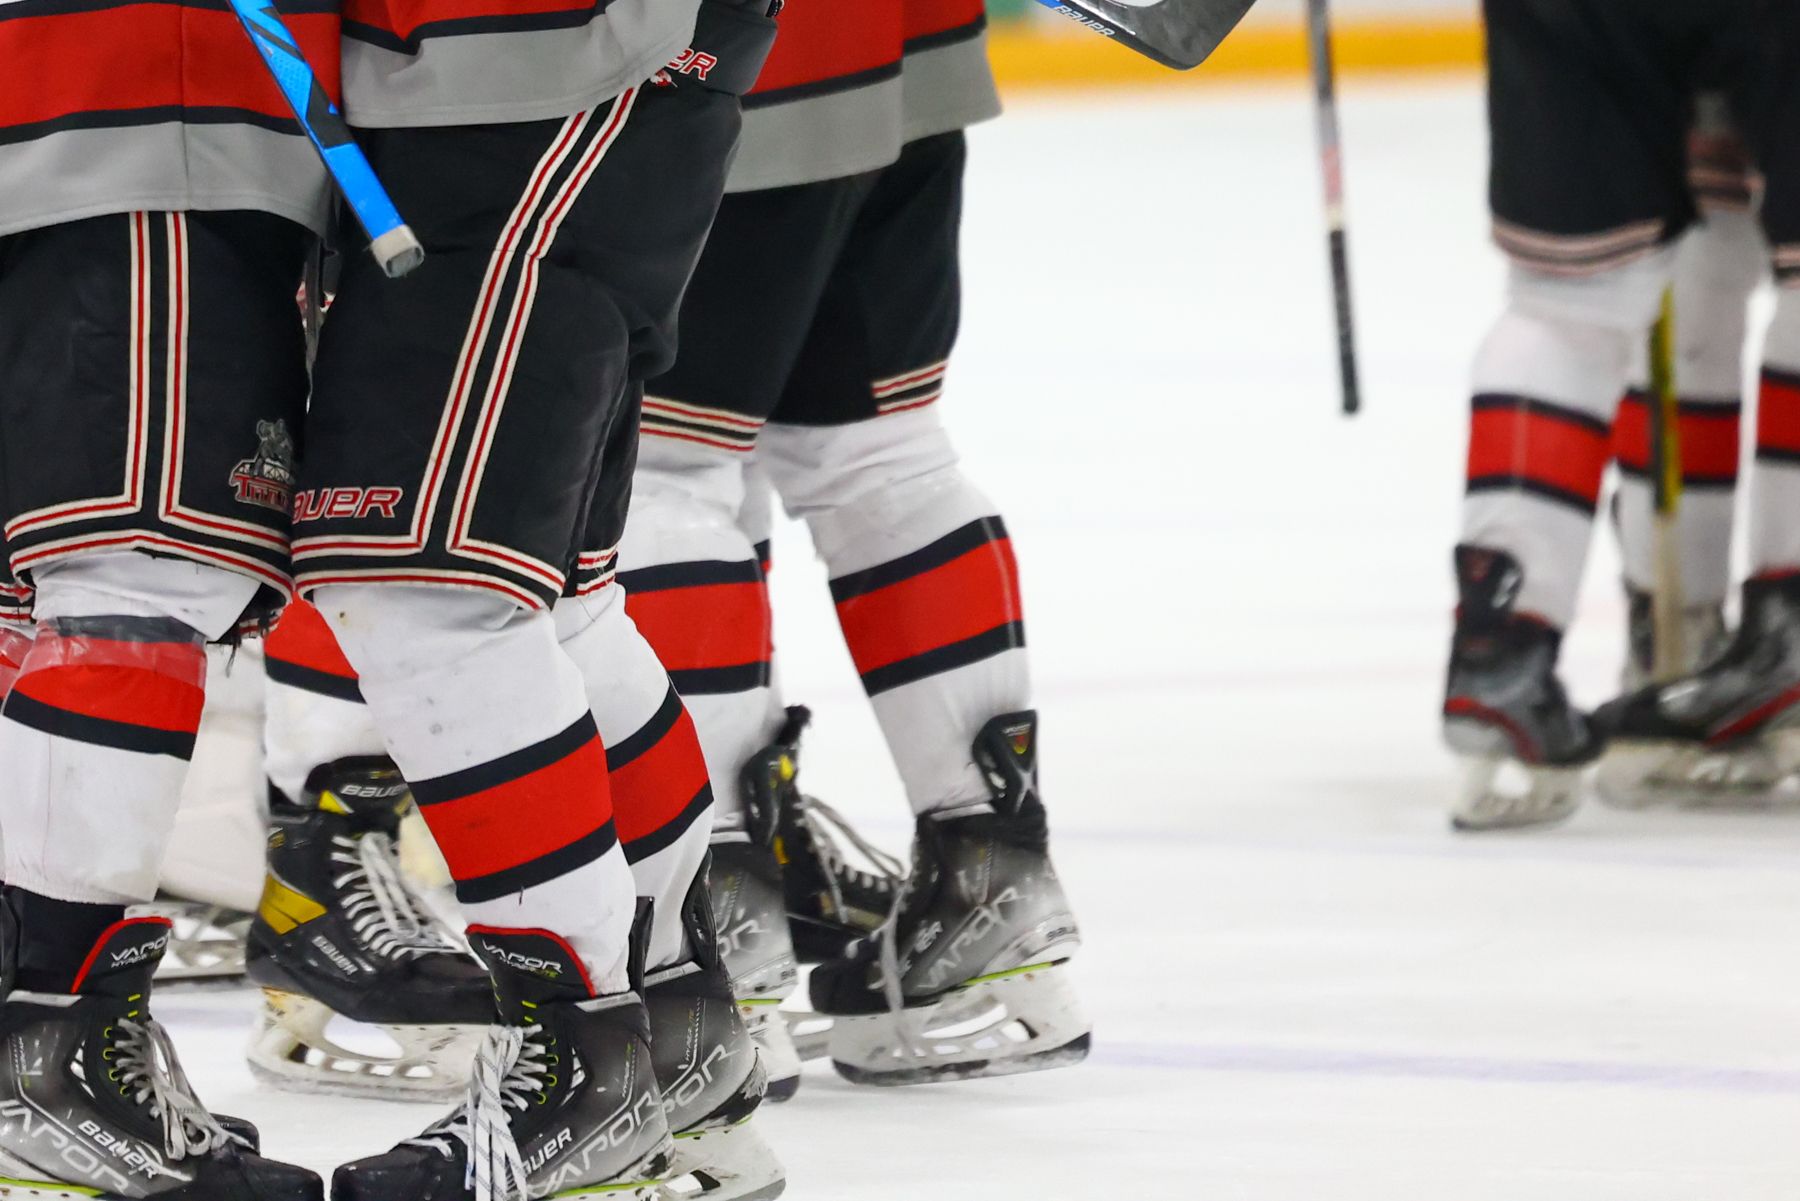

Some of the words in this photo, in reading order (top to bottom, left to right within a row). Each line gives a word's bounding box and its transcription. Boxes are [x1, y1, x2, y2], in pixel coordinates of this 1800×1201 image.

[1055, 4, 1116, 37] BAUER
[482, 939, 563, 974] VAPOR
[77, 1118, 158, 1179] BAUER
